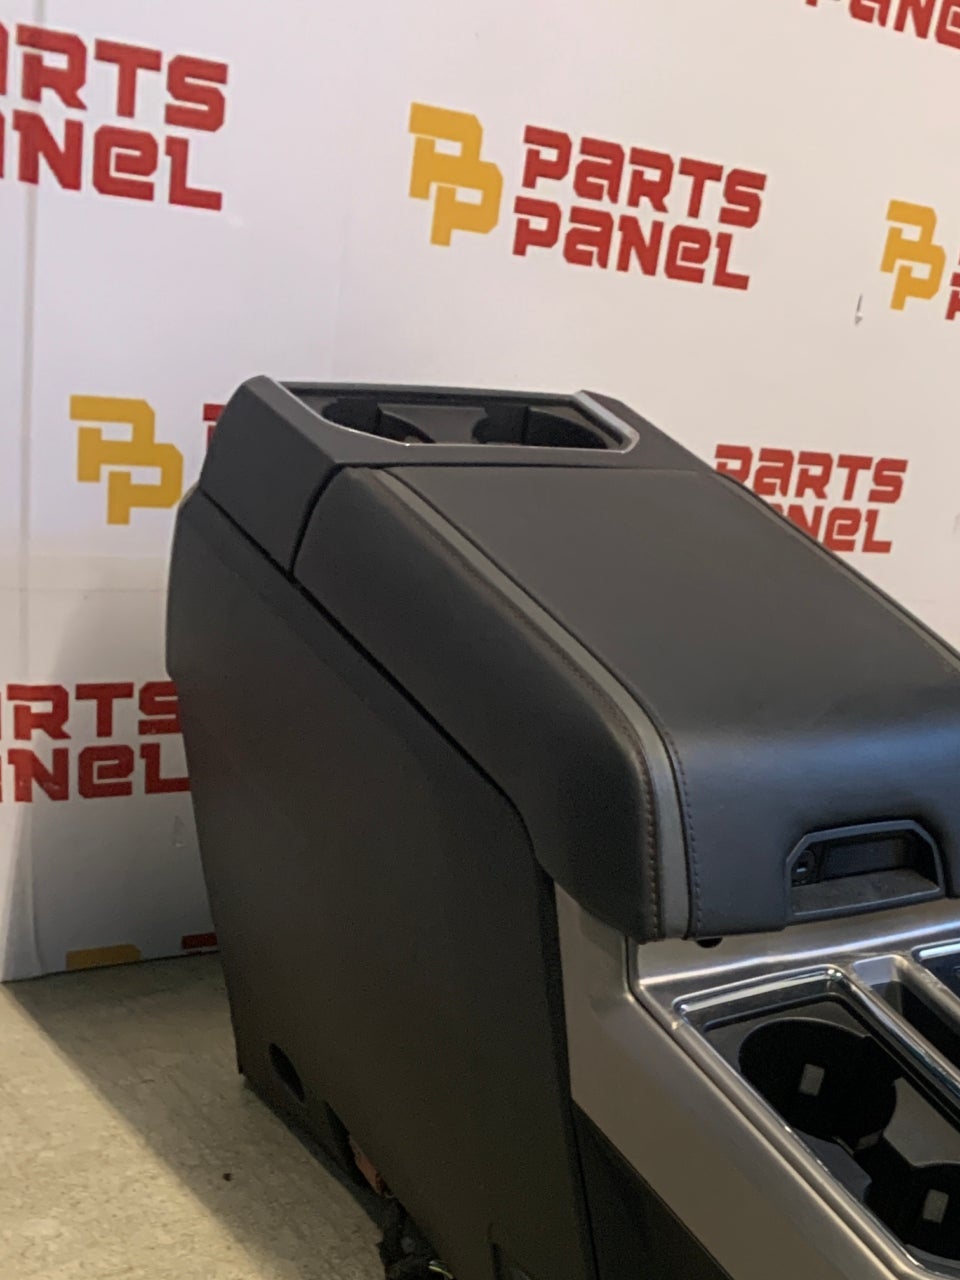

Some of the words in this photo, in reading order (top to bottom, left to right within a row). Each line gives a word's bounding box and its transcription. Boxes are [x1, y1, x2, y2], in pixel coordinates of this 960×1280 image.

[0, 21, 228, 132] RTS
[0, 110, 222, 211] NEL
[0, 682, 182, 741] RTS
[0, 743, 191, 803] NEL
